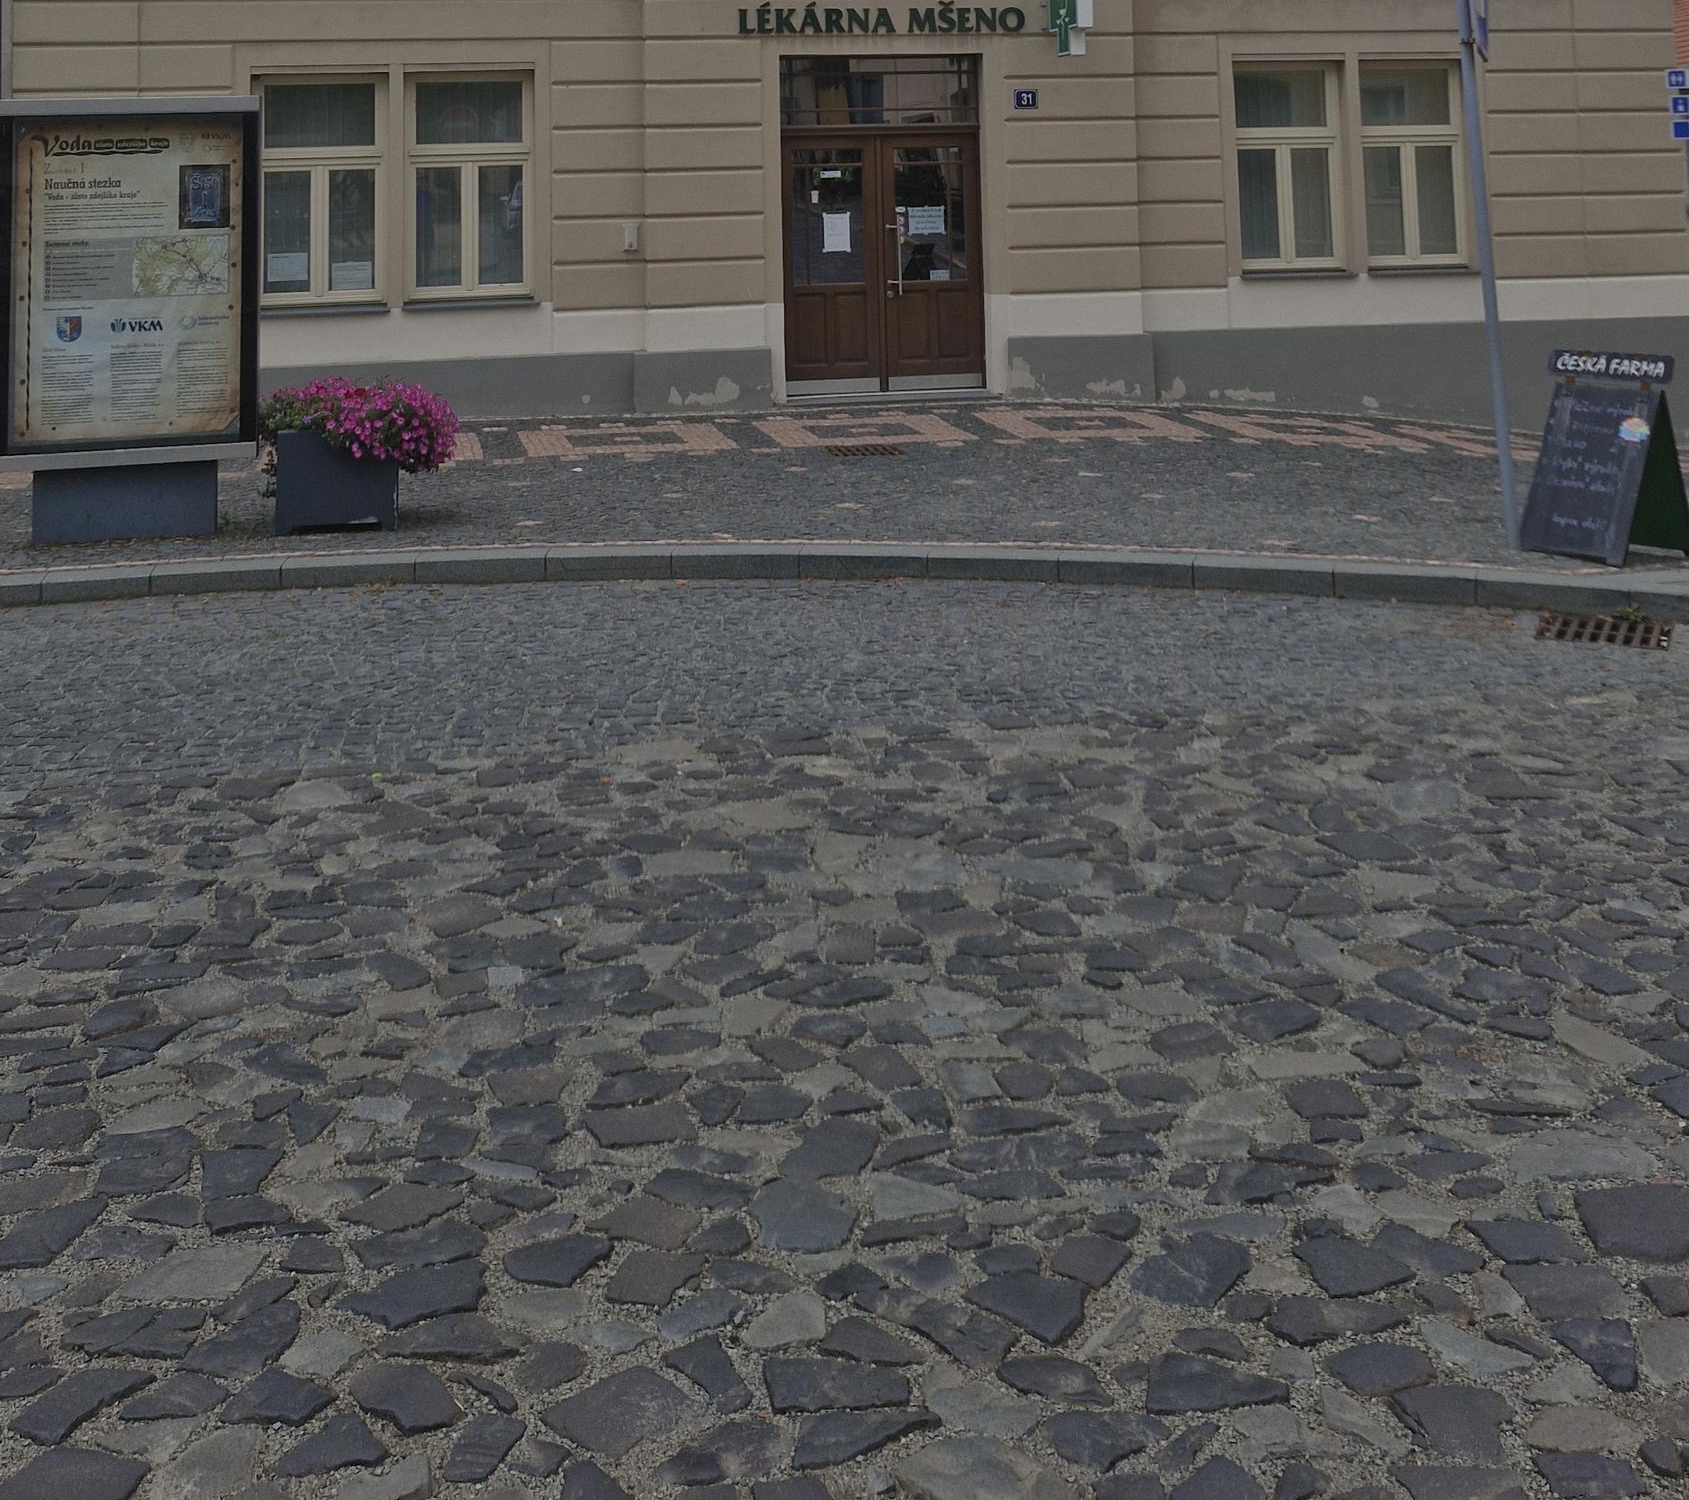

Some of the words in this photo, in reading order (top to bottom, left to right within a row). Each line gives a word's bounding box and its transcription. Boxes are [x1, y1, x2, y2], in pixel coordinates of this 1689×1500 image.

[737, 0, 897, 34] LÉKÁRNA
[907, 0, 1026, 34] MŠENO
[1021, 92, 1033, 106] 31
[31, 134, 93, 158] Voda
[44, 177, 86, 190] Naučná
[88, 176, 122, 189] stezka
[128, 319, 163, 333] VKM
[1556, 352, 1607, 374] ČESKÁ
[1608, 358, 1666, 379] FARMA
